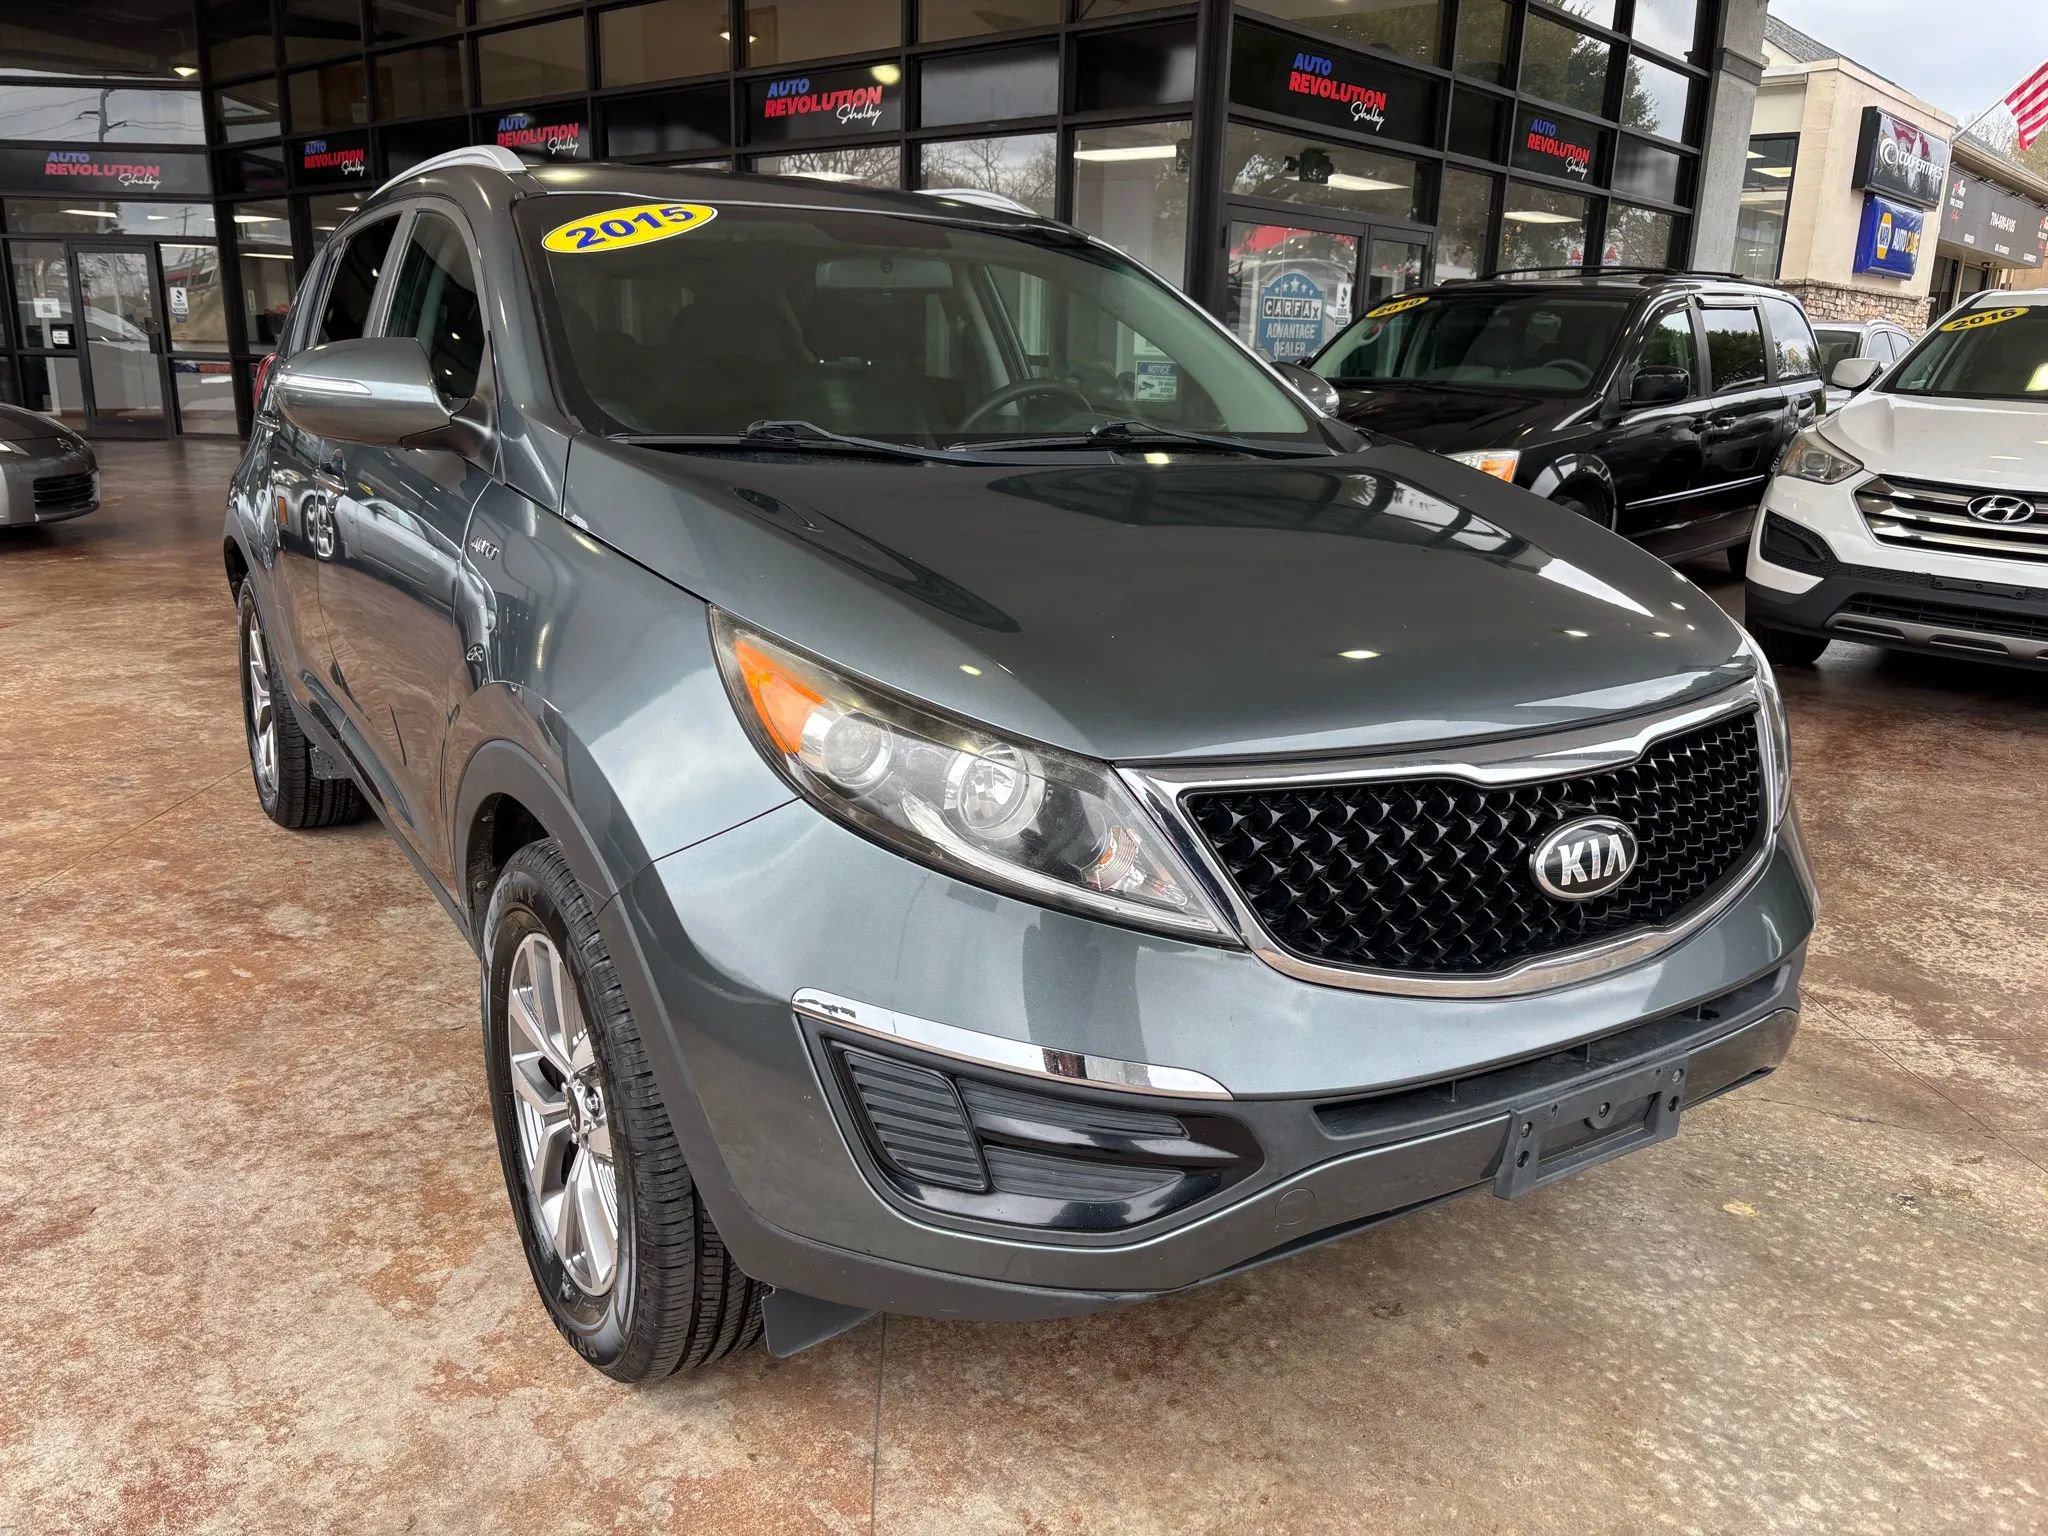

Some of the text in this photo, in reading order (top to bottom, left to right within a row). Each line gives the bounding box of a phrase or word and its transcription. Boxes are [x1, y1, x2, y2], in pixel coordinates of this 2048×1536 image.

[1293, 52, 1332, 76] AUTO
[767, 78, 810, 98] AUTO
[1289, 71, 1386, 111] REVOLUTION
[764, 85, 883, 118] REVOLUTION
[836, 99, 883, 126] Shelby
[1350, 101, 1385, 132] Shelby
[496, 122, 579, 147] REVOLUTION
[498, 117, 529, 132] AUTO
[1530, 118, 1556, 137] AUTO
[304, 142, 327, 155] AUTO
[547, 134, 579, 156] Shelby
[1527, 132, 1590, 163] REVOLUTION
[47, 151, 90, 163] AUTO
[304, 148, 364, 169] REVOLUTION
[341, 157, 365, 177] Shelby
[44, 162, 160, 177] REVOLUTION
[1565, 156, 1588, 181] Shelby
[118, 172, 161, 190] Shelby
[565, 206, 695, 249] 2015
[1264, 299, 1320, 319] CARFAX
[1952, 309, 2017, 330] 2016
[1266, 323, 1317, 340] ADVANTAGE
[1273, 341, 1306, 359] DEALER
[1557, 833, 1627, 886] KIA
